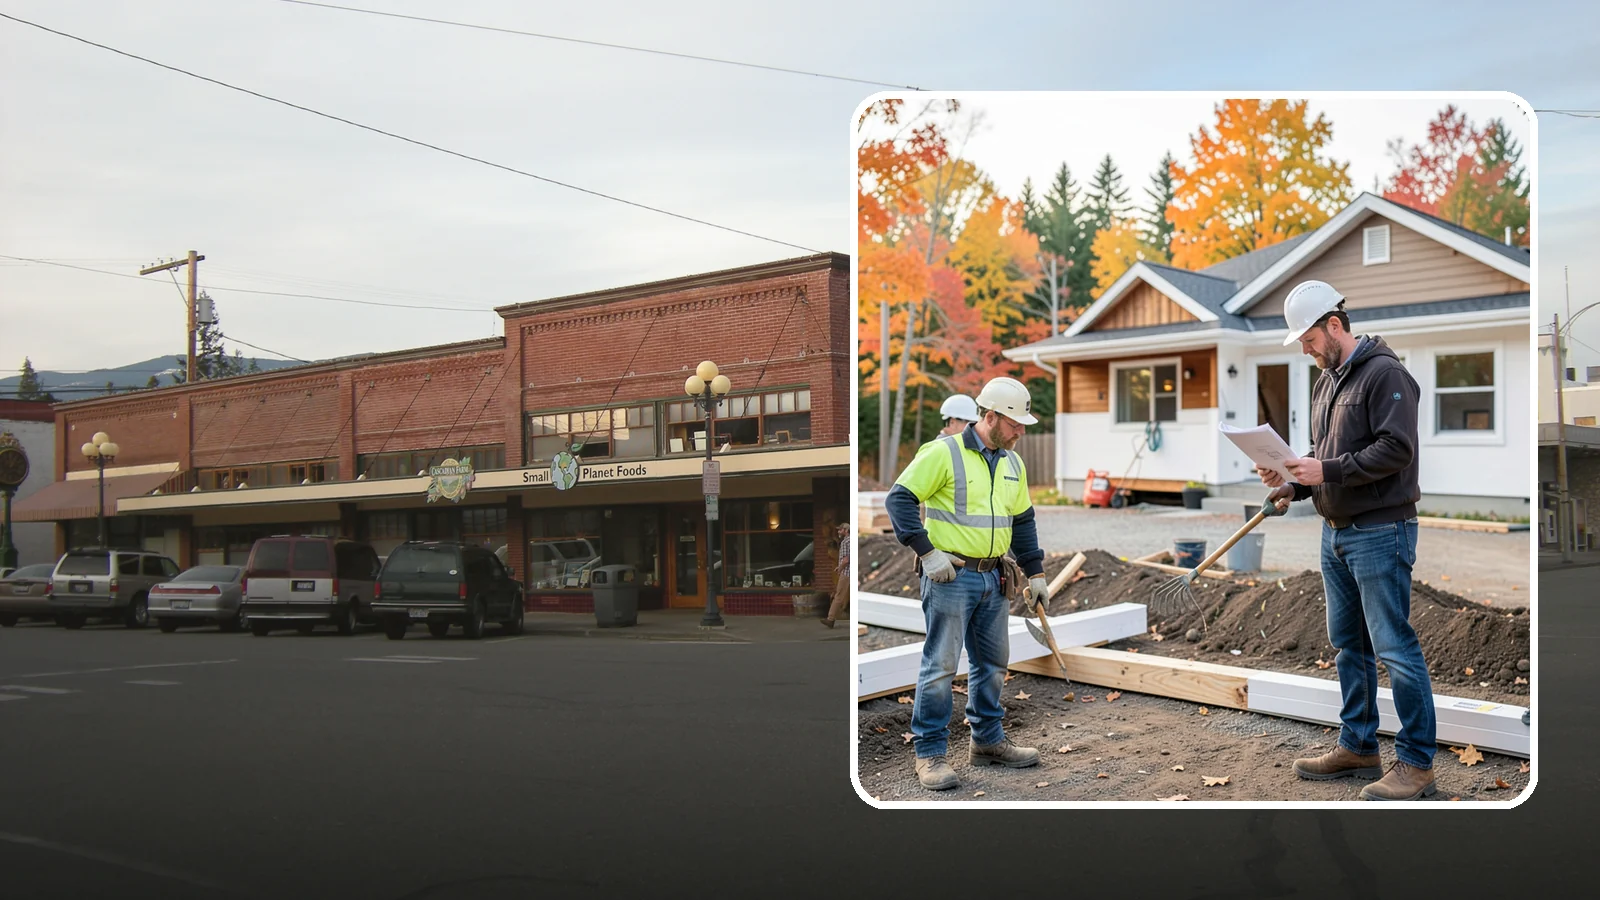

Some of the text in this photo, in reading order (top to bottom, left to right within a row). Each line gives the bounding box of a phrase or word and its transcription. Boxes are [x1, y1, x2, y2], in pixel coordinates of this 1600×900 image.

[523, 464, 647, 483] Small Planet Foods
